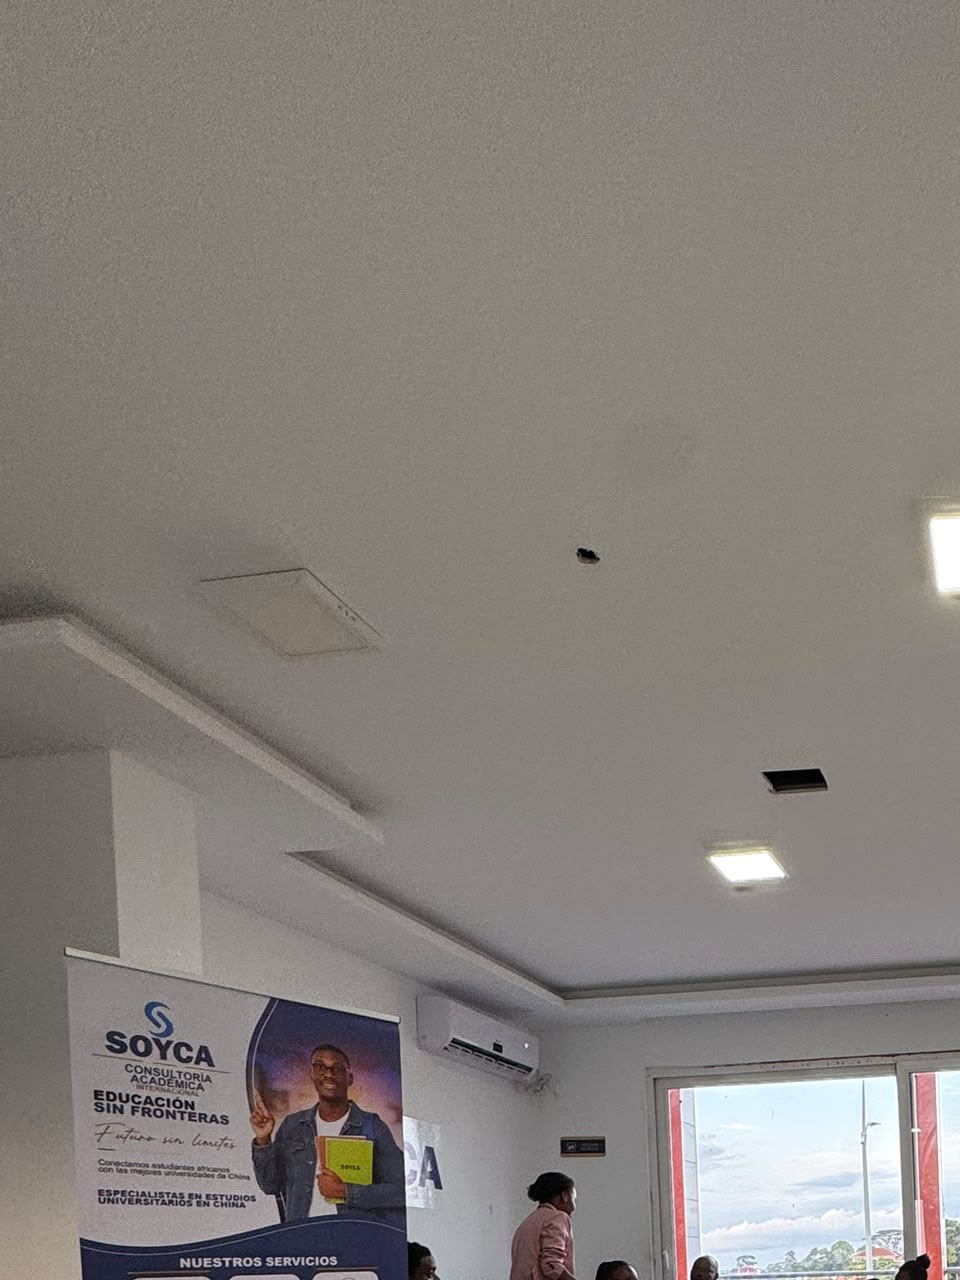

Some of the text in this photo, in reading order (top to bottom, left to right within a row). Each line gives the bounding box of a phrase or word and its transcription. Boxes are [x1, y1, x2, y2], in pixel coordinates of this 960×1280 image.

[105, 1031, 215, 1067] SOYCA
[125, 1064, 212, 1083] CONSULTORÍA
[93, 1090, 195, 1110] EDUCACIÓN
[94, 1102, 229, 1125] SIN FRONTERAS
[95, 1123, 156, 1144] Futuro
[163, 1136, 184, 1144] sin
[98, 1159, 230, 1173] Conectamos estudiantes africanos
[131, 1168, 162, 1176] mejores
[164, 1170, 215, 1179] universidades
[98, 1189, 185, 1199] ESPECIALISTAS
[206, 1194, 256, 1202] ESTUDIOS
[98, 1197, 193, 1207] UNIVERSITARIOS
[213, 1200, 246, 1208] CHINA
[180, 1257, 337, 1268] NUESTROS SERVICIOS
